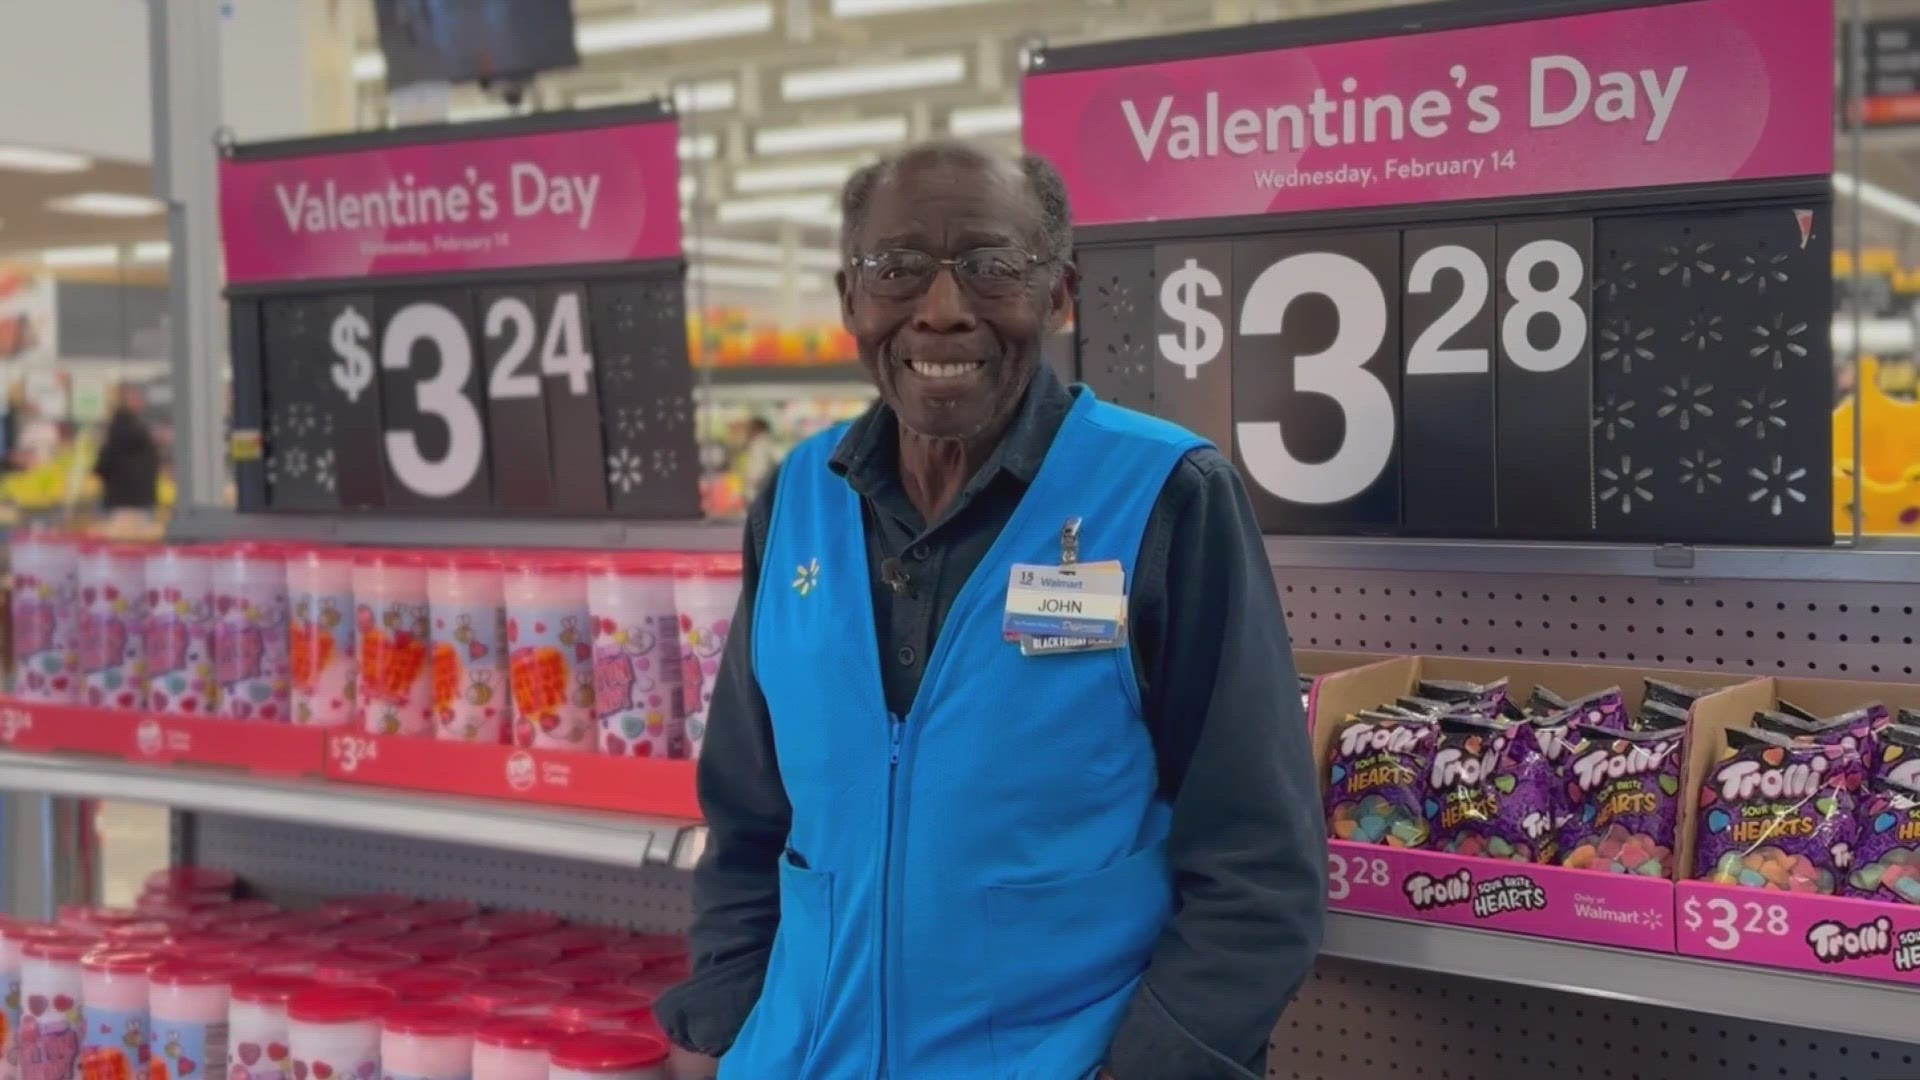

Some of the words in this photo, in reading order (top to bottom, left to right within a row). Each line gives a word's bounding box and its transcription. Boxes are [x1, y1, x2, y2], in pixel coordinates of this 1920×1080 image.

[1121, 65, 1500, 164] Valentine's
[1530, 56, 1688, 142] Day
[1253, 165, 1378, 190] Wednesday,
[1385, 156, 1485, 181] February
[1491, 150, 1517, 171] 14
[275, 167, 498, 233] Valentine's
[511, 163, 600, 229] Day
[1040, 577, 1083, 590] Walmart
[1037, 598, 1083, 614] JOHN
[1347, 765, 1416, 793] HEARTS
[1717, 756, 1828, 800] Trolli
[1732, 816, 1813, 842] HEARTS
[1407, 871, 1471, 906] Trolli
[1474, 888, 1545, 916] HEARTS
[1574, 904, 1640, 925] Walmart
[1808, 917, 1890, 958] Trolli
